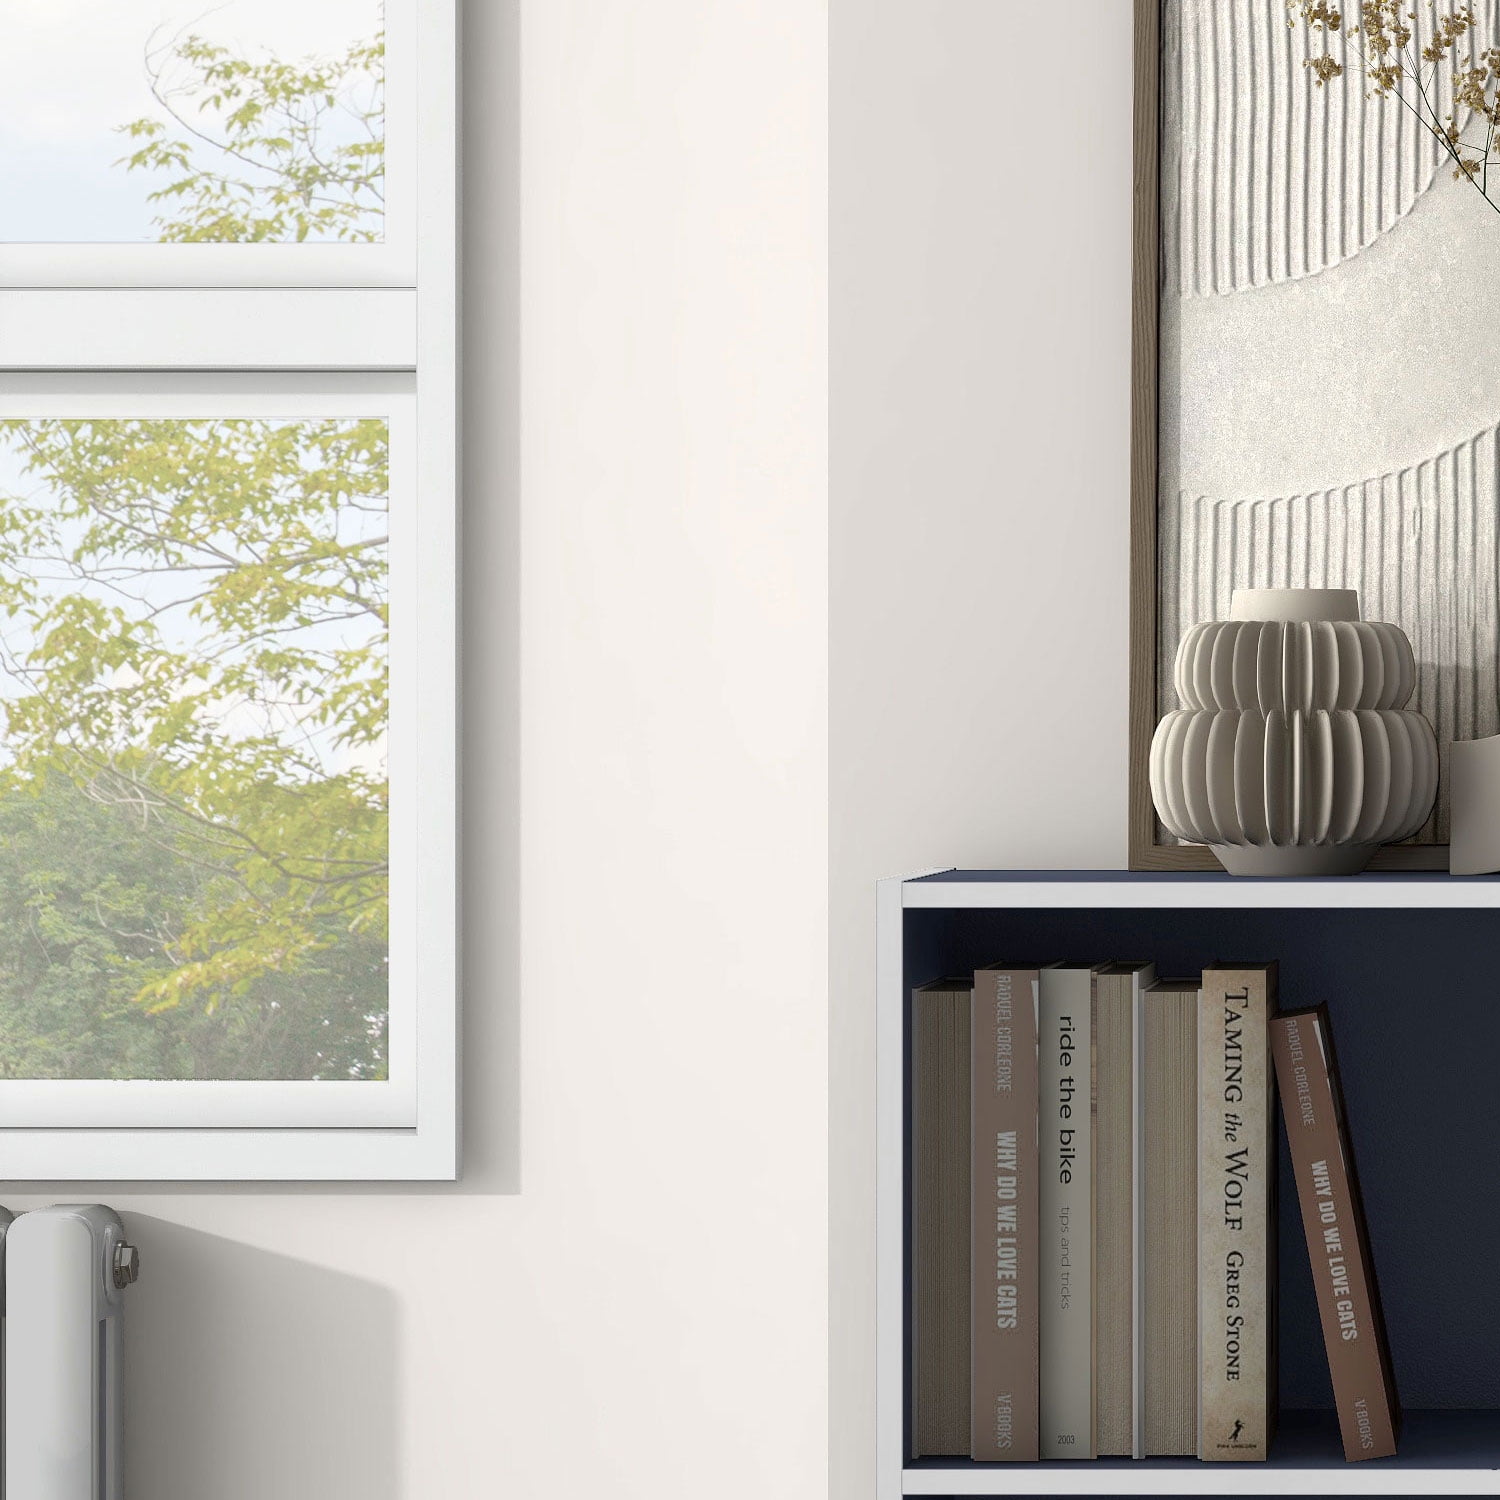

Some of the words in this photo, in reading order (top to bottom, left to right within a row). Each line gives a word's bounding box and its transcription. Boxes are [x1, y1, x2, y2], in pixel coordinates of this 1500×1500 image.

[997, 974, 1012, 1023] RAQUEL
[997, 1027, 1012, 1092] CORLEONE
[1059, 1015, 1076, 1068] ride
[1224, 986, 1249, 1104] TAMING
[1285, 1019, 1303, 1065] RAQUEL
[1294, 1066, 1316, 1127] CORLEONE
[1059, 1075, 1076, 1120] the
[1225, 1112, 1242, 1143] the
[996, 1130, 1017, 1172] WHY
[1059, 1129, 1076, 1185] bike
[996, 1175, 1017, 1200] DO
[1224, 1147, 1249, 1232] WOLF
[1310, 1159, 1332, 1198] WHY
[996, 1205, 1017, 1233] WE
[1059, 1206, 1070, 1233] tips
[1317, 1201, 1337, 1224] DO
[996, 1236, 1017, 1280] LOVE
[1061, 1238, 1071, 1267] and
[1322, 1227, 1343, 1254] WE
[1061, 1271, 1071, 1310] tricks
[1226, 1250, 1245, 1310] GREG
[1329, 1257, 1350, 1297] LOVE
[996, 1284, 1017, 1330] CATS
[1336, 1300, 1358, 1341] CATS
[1226, 1315, 1245, 1382] STONE
[1057, 1435, 1075, 1445] 2003
